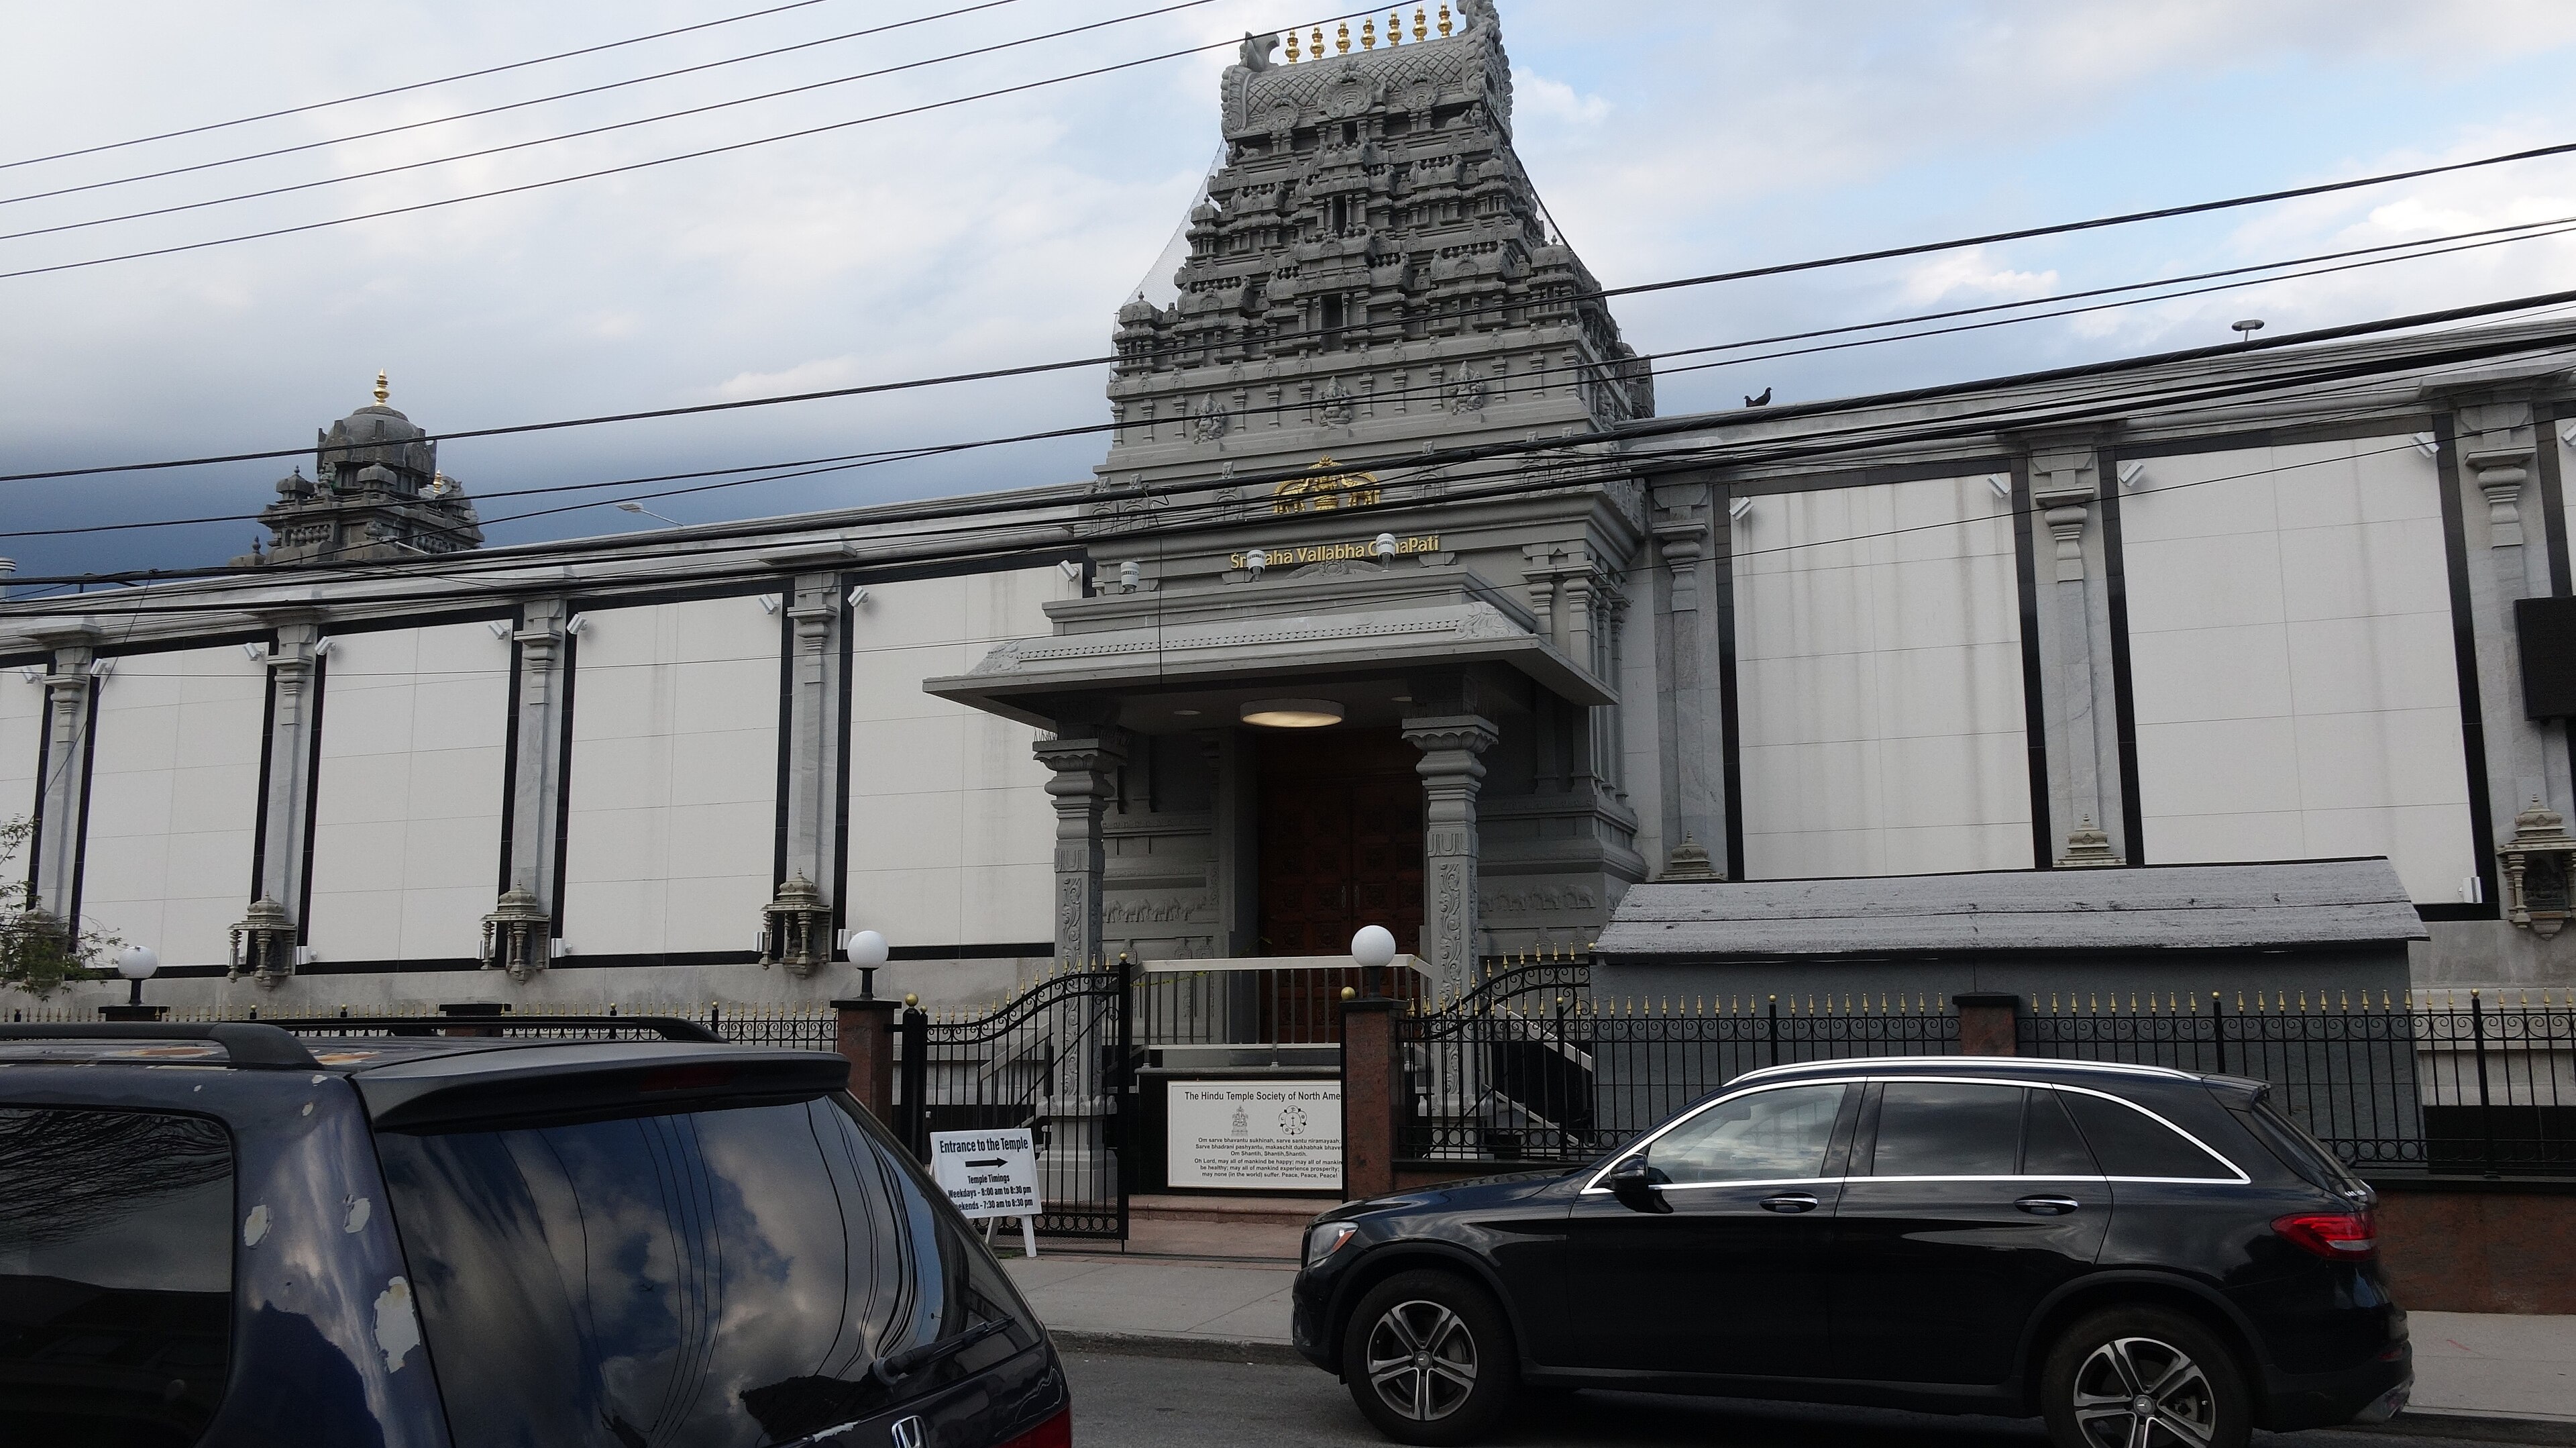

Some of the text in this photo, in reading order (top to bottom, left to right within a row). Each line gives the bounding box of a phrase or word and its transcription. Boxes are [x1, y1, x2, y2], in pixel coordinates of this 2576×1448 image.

[1297, 543, 1364, 562] Vallabha
[1185, 1091, 1340, 1102] The Hindu Temple Society of North Ame
[940, 1136, 1028, 1153] Entrance to the Temple
[967, 1174, 1010, 1186] Temple Timings
[948, 1188, 977, 1199] Weekdays
[981, 1187, 994, 1196] 8:00
[1004, 1186, 1010, 1194] to
[1010, 1186, 1022, 1194] 8:30
[1023, 1186, 1032, 1195] pm
[957, 1200, 979, 1211] ekends
[983, 1200, 995, 1209] 7:30
[1005, 1199, 1011, 1207] to
[1012, 1198, 1024, 1207] 8:30
[1024, 1198, 1033, 1208] pm
